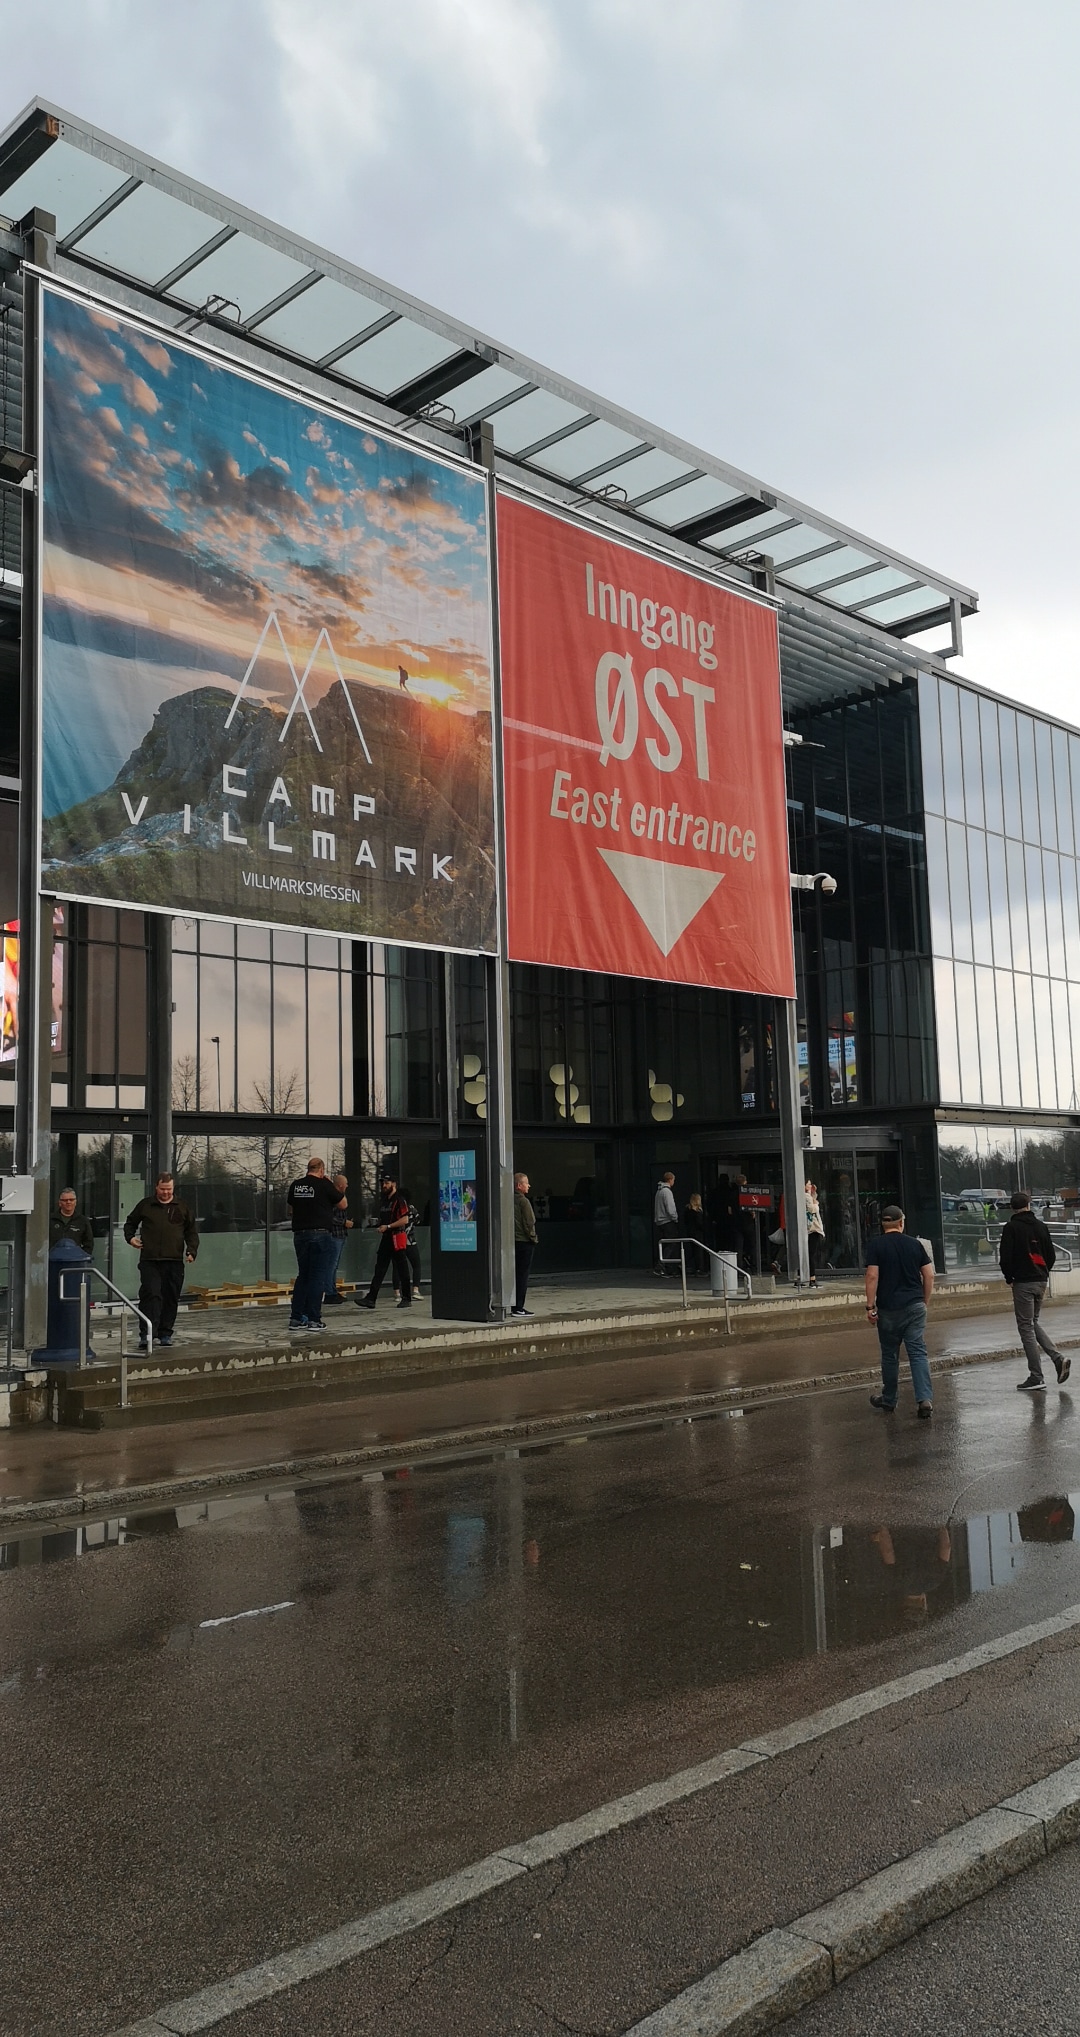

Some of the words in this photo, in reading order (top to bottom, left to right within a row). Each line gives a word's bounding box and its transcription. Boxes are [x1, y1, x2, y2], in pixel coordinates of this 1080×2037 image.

[585, 562, 718, 670] Inngang
[595, 651, 715, 781] ØST
[120, 791, 454, 882] VILLMARK
[222, 763, 376, 821] CAMP
[550, 769, 622, 832] East
[630, 801, 756, 862] entrance
[242, 870, 361, 904] VILLMARKSMESSEN
[449, 1154, 465, 1168] DYR
